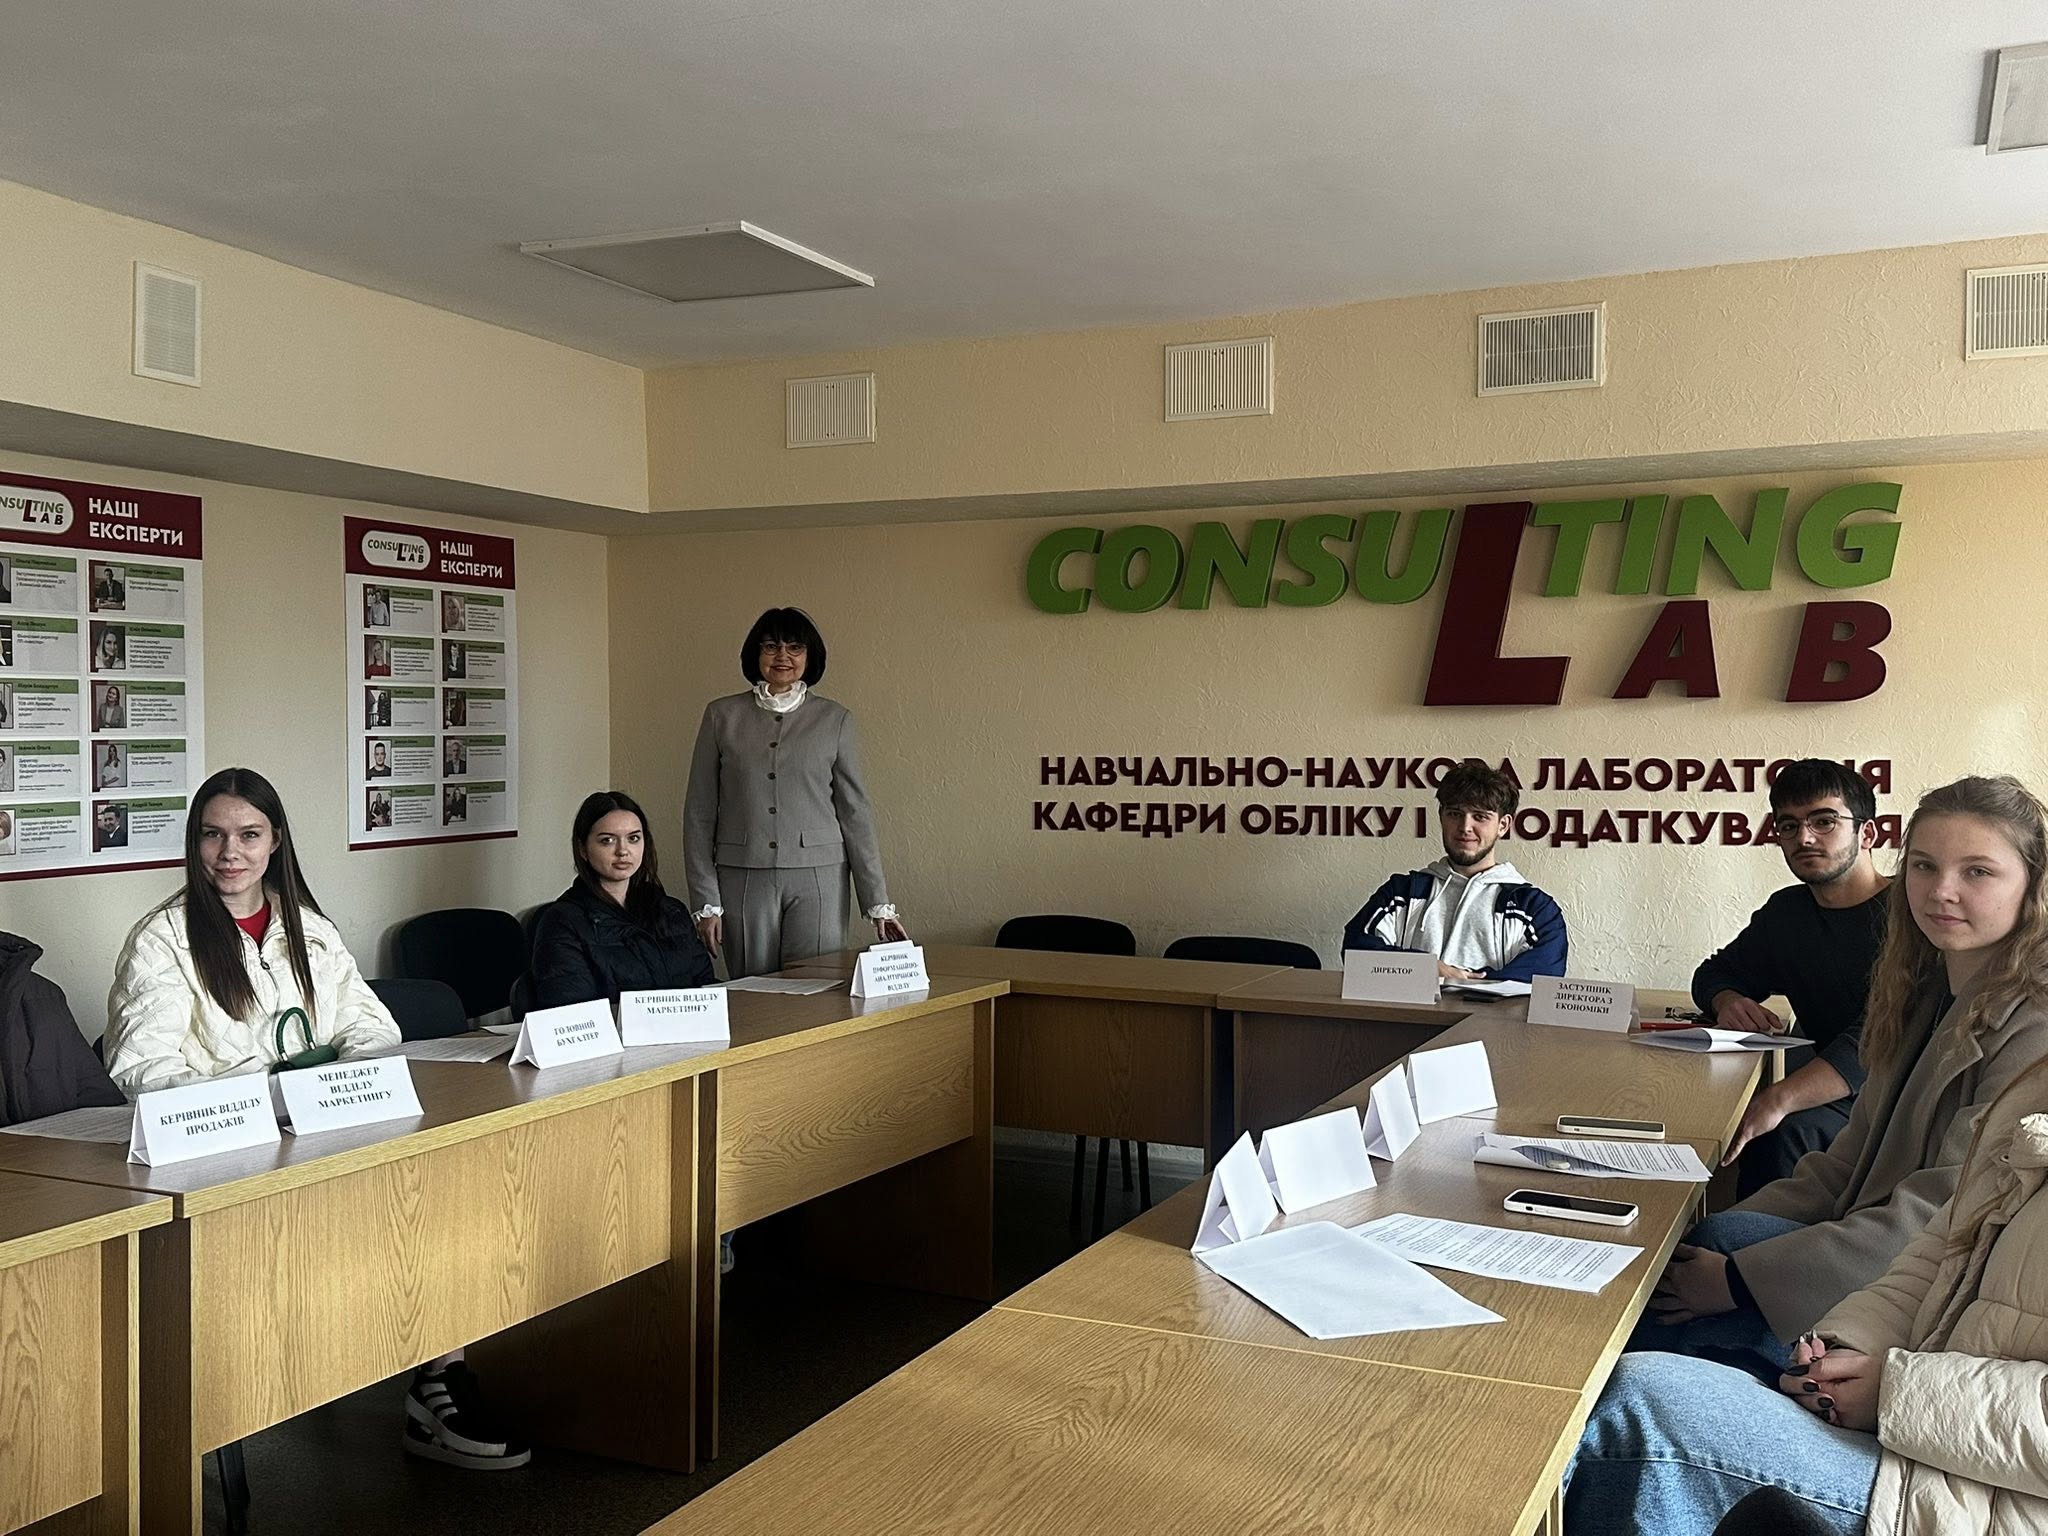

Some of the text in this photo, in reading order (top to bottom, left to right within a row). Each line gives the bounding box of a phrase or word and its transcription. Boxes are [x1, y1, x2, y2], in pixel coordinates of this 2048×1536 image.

[88, 497, 139, 518] НАШІ
[89, 521, 183, 546] ЕКСПЕРТИ
[367, 539, 424, 561] CONSULTING
[440, 541, 473, 557] НАШІ
[441, 560, 503, 578] ЕКСПЕРТИ
[1026, 482, 1903, 706] CONSULTING
[1533, 758, 1891, 794] ЛАБОРАТЯ
[1033, 802, 1902, 849] КАФЕДРИ ОБЛІКУ І ОДАТКУВАЯ
[1371, 966, 1413, 975] ДИРЕКТОР
[1558, 982, 1612, 994] ЗАСТУПНИК
[635, 993, 719, 1004] КЕРІВНИК ВІДДІЛУ
[1554, 993, 1606, 1004] ДИРЕКТОРА
[647, 1004, 709, 1014] МАРКЕТИНГУ
[1555, 1003, 1610, 1014] ЕКОНОМІКИ
[554, 1019, 596, 1035] ГОЛОВНИЙ
[556, 1031, 599, 1047] БУХГАЛТЕР
[318, 1066, 379, 1083] МЕНЕДЖЕР
[330, 1080, 375, 1094] ВІДДІЛУ
[318, 1090, 393, 1108] МАРКЕТИНГУ
[160, 1097, 263, 1126] КЕРІВНИК ВІДДІЛУ
[186, 1115, 245, 1136] ПРОДАЖІВ
